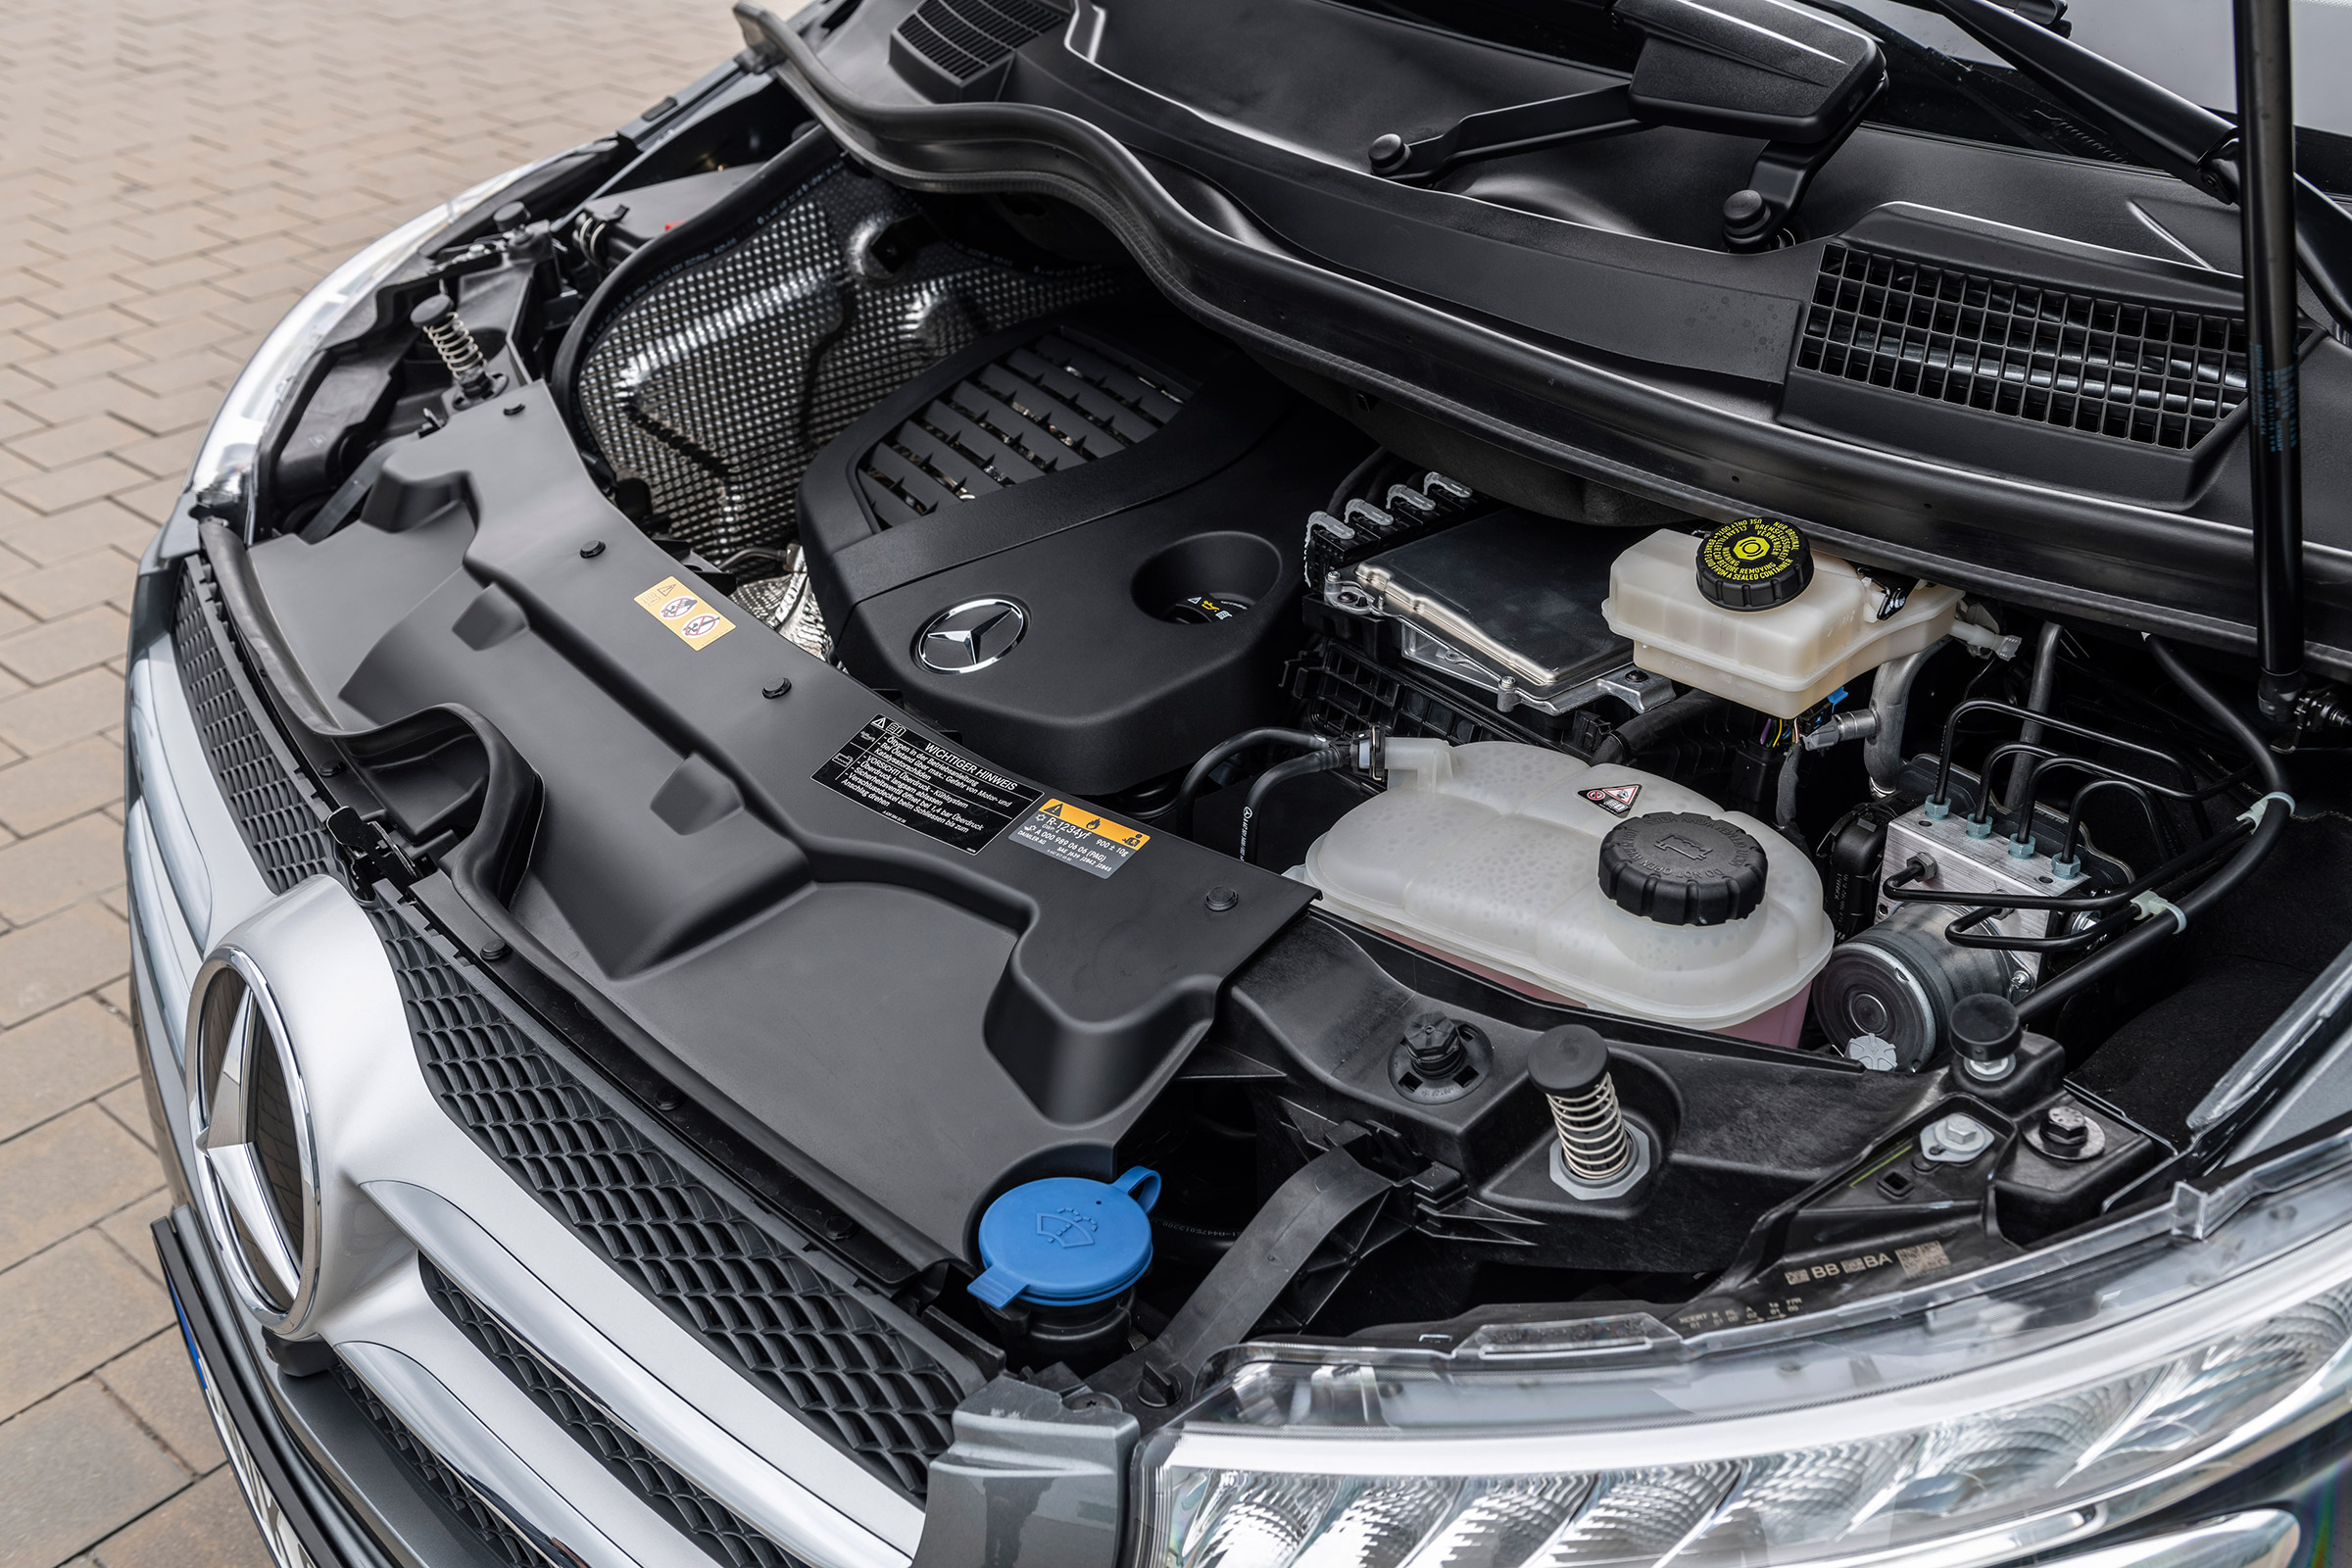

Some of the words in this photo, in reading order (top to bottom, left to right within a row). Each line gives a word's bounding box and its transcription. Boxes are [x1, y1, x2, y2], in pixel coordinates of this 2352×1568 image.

[2275, 419, 2283, 452] GERMANY
[1726, 526, 1747, 536] CLEAN
[1732, 520, 1747, 529] ONLY
[1774, 521, 1788, 530] NUR
[1785, 528, 1799, 550] ORIGINAL
[1704, 538, 1715, 554] BRAKE
[1713, 552, 1723, 561] CAP
[1723, 547, 1740, 566] WARNING
[1757, 530, 1782, 556] VERWENDEN
[1704, 555, 1716, 567] FLUID
[1711, 565, 1729, 577] FROM
[1717, 560, 1740, 574] BEFORE
[1740, 562, 1777, 574] REMOVING
[1759, 559, 1793, 579] CONTAINER
[871, 748, 931, 780] Katalysatorschäden
[880, 742, 893, 751] Bei
[891, 747, 915, 763] Ölstand
[913, 760, 929, 770] über
[945, 775, 966, 788] Gefahr
[977, 790, 998, 801] Motor-
[884, 736, 910, 752] Öltypen
[927, 758, 978, 786] Betriebsanleitung
[925, 743, 977, 773] WICHTIGER
[975, 768, 1017, 790] HINWEIS
[841, 778, 869, 797] Anschlag
[867, 793, 890, 807] drehen
[859, 761, 892, 780] Überdruck
[890, 777, 916, 793] langsam
[915, 791, 943, 806] ablassen
[865, 756, 901, 775] VORSICHT!
[899, 771, 933, 791] Überdruck
[933, 789, 968, 808] Kühlsystem
[849, 772, 900, 802] Verschlussdeckel
[897, 798, 914, 809] beim
[913, 806, 946, 823] Schliessen
[854, 767, 904, 795] Sicherheitsventil
[901, 791, 921, 804] öffnet
[919, 800, 932, 808] bei
[952, 812, 983, 830] Überdruck
[1041, 831, 1055, 840] 000
[1054, 836, 1069, 846] 989
[1086, 850, 1106, 862] (PAG)
[1044, 816, 1091, 839] R-1234yf
[1096, 838, 1110, 848] 900
[1115, 847, 1129, 857] 10g
[1017, 830, 1039, 841] DAIMLER
[1079, 856, 1096, 865] J2842
[1095, 862, 1111, 871] J2845
[1640, 859, 1673, 875] OPEN
[1705, 868, 1725, 878] DO
[1811, 1263, 1840, 1279] BB
[1863, 1253, 1892, 1268] BA
